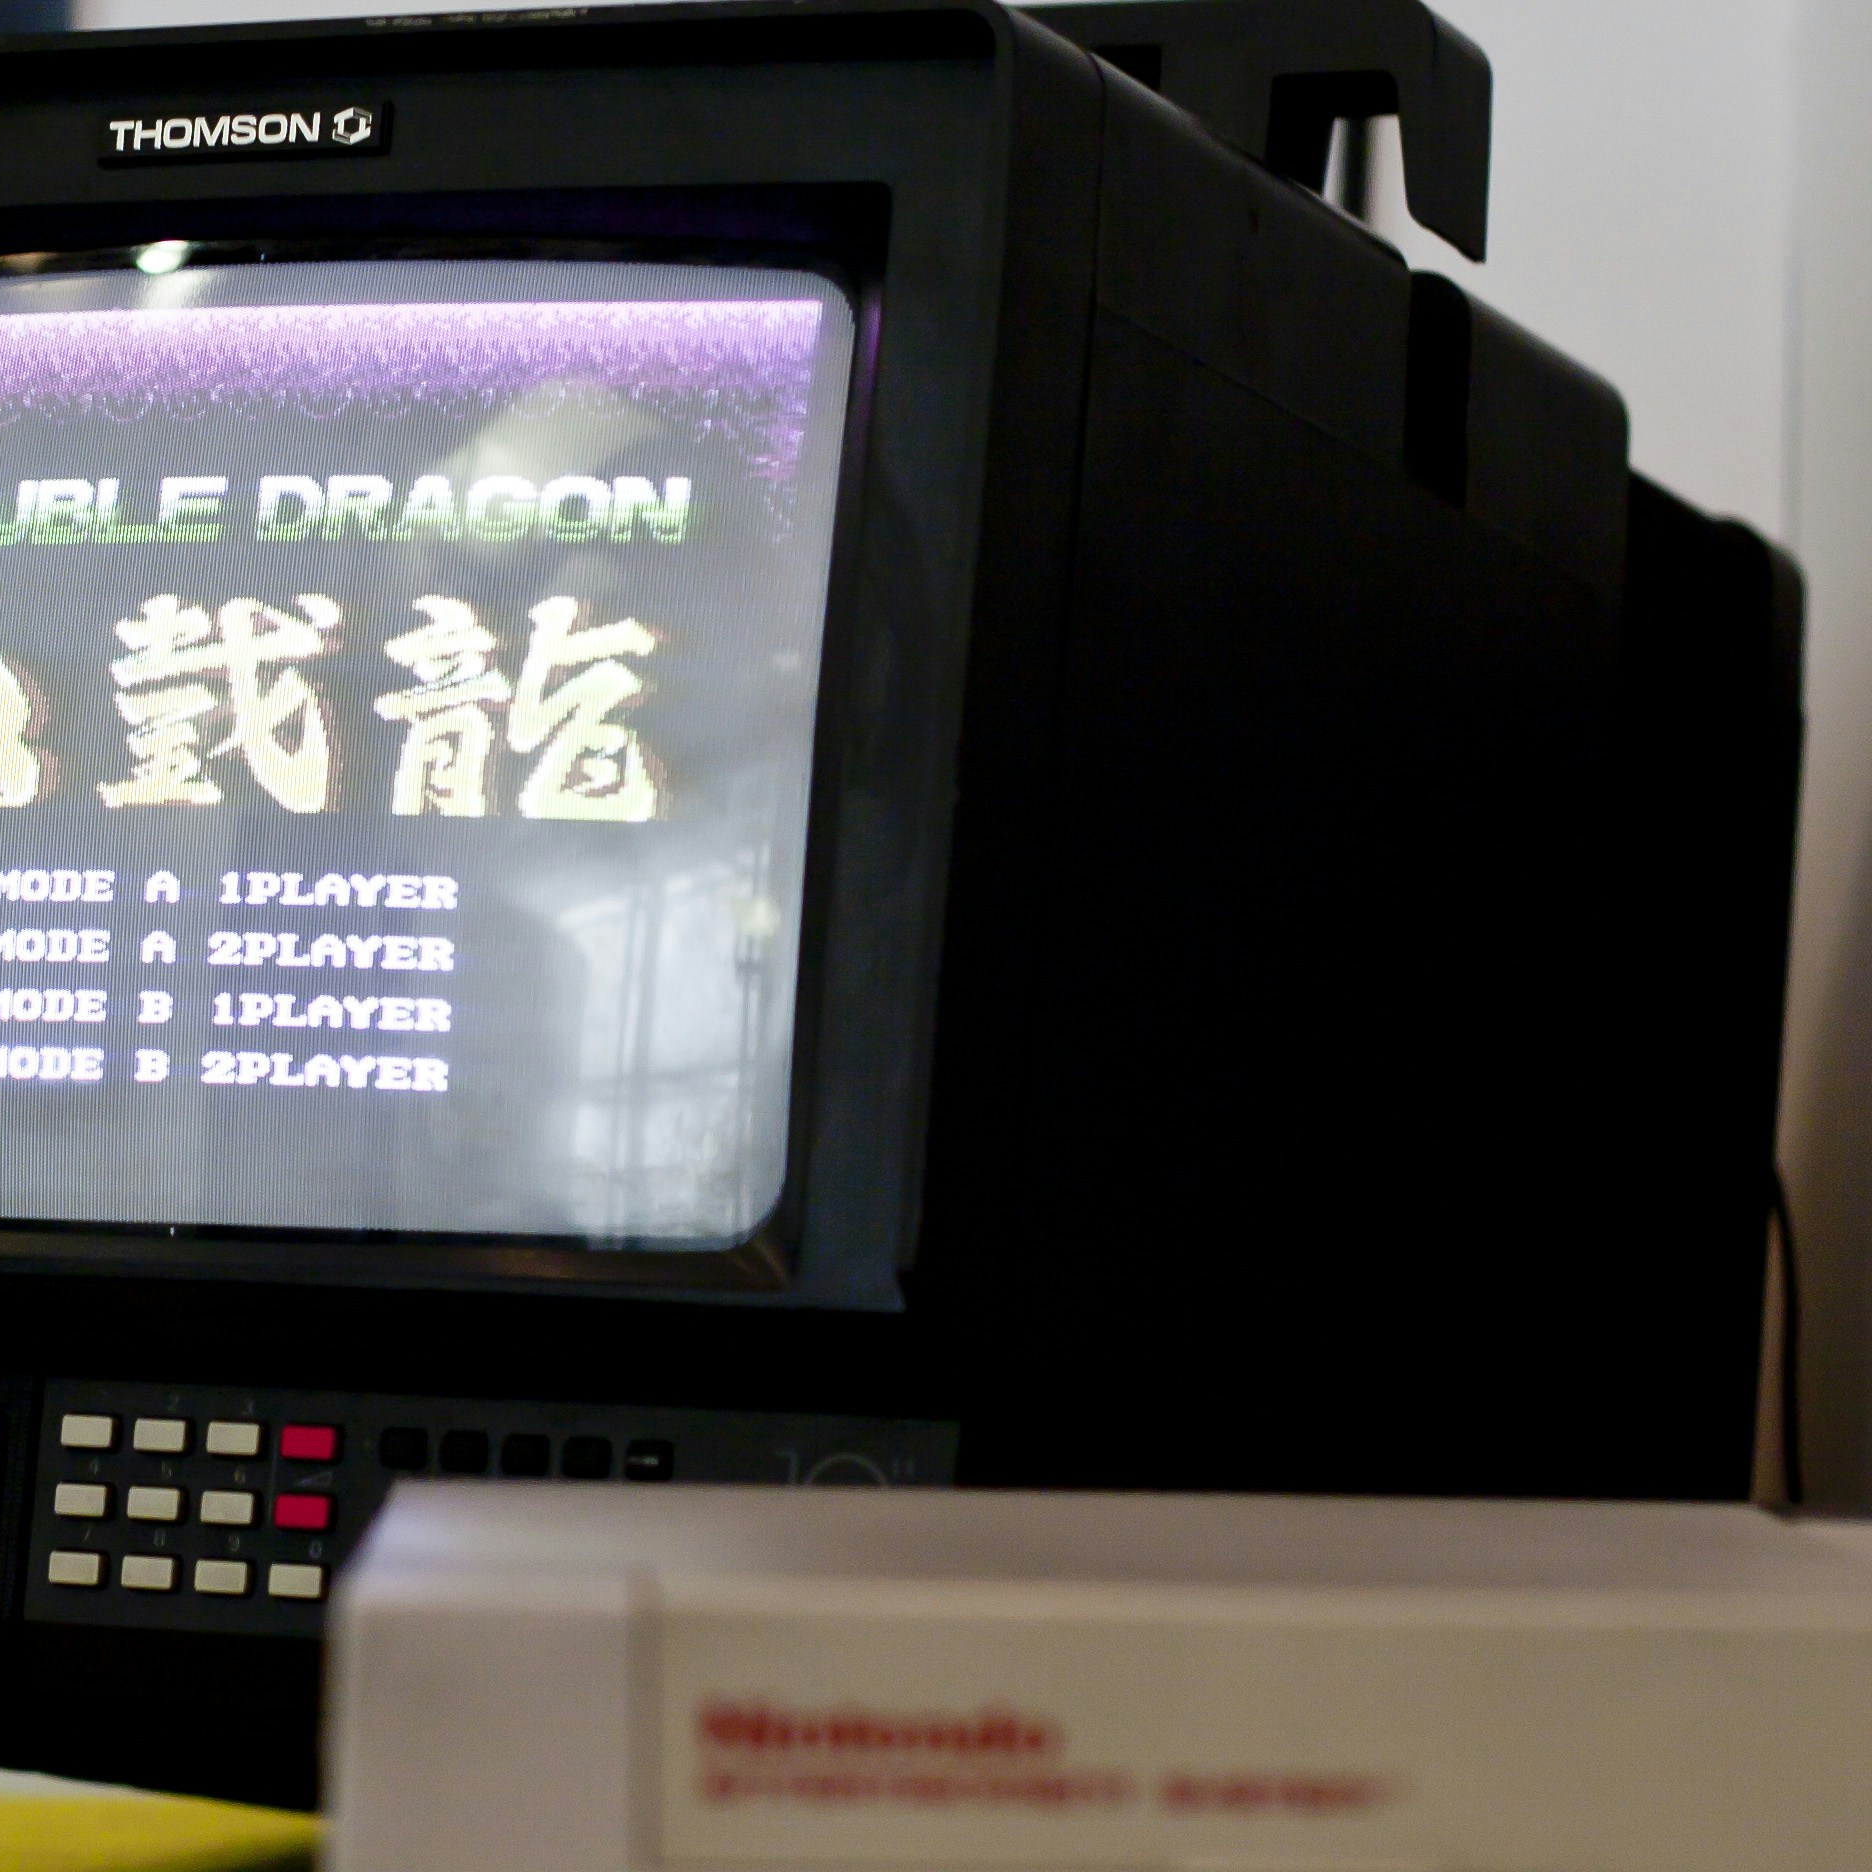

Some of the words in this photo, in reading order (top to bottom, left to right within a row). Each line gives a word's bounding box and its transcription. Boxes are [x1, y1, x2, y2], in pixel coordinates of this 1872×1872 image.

[109, 111, 322, 151] THOMSON
[255, 474, 692, 544] DRAGON
[144, 869, 181, 904] A
[219, 871, 459, 909] 1PLAYER
[140, 929, 177, 964] A
[207, 931, 455, 970] 2PLAYER
[137, 990, 174, 1025] B
[212, 992, 453, 1031] 1PLAYER
[133, 1048, 171, 1084] B
[200, 1050, 449, 1092] 2PLAYER
